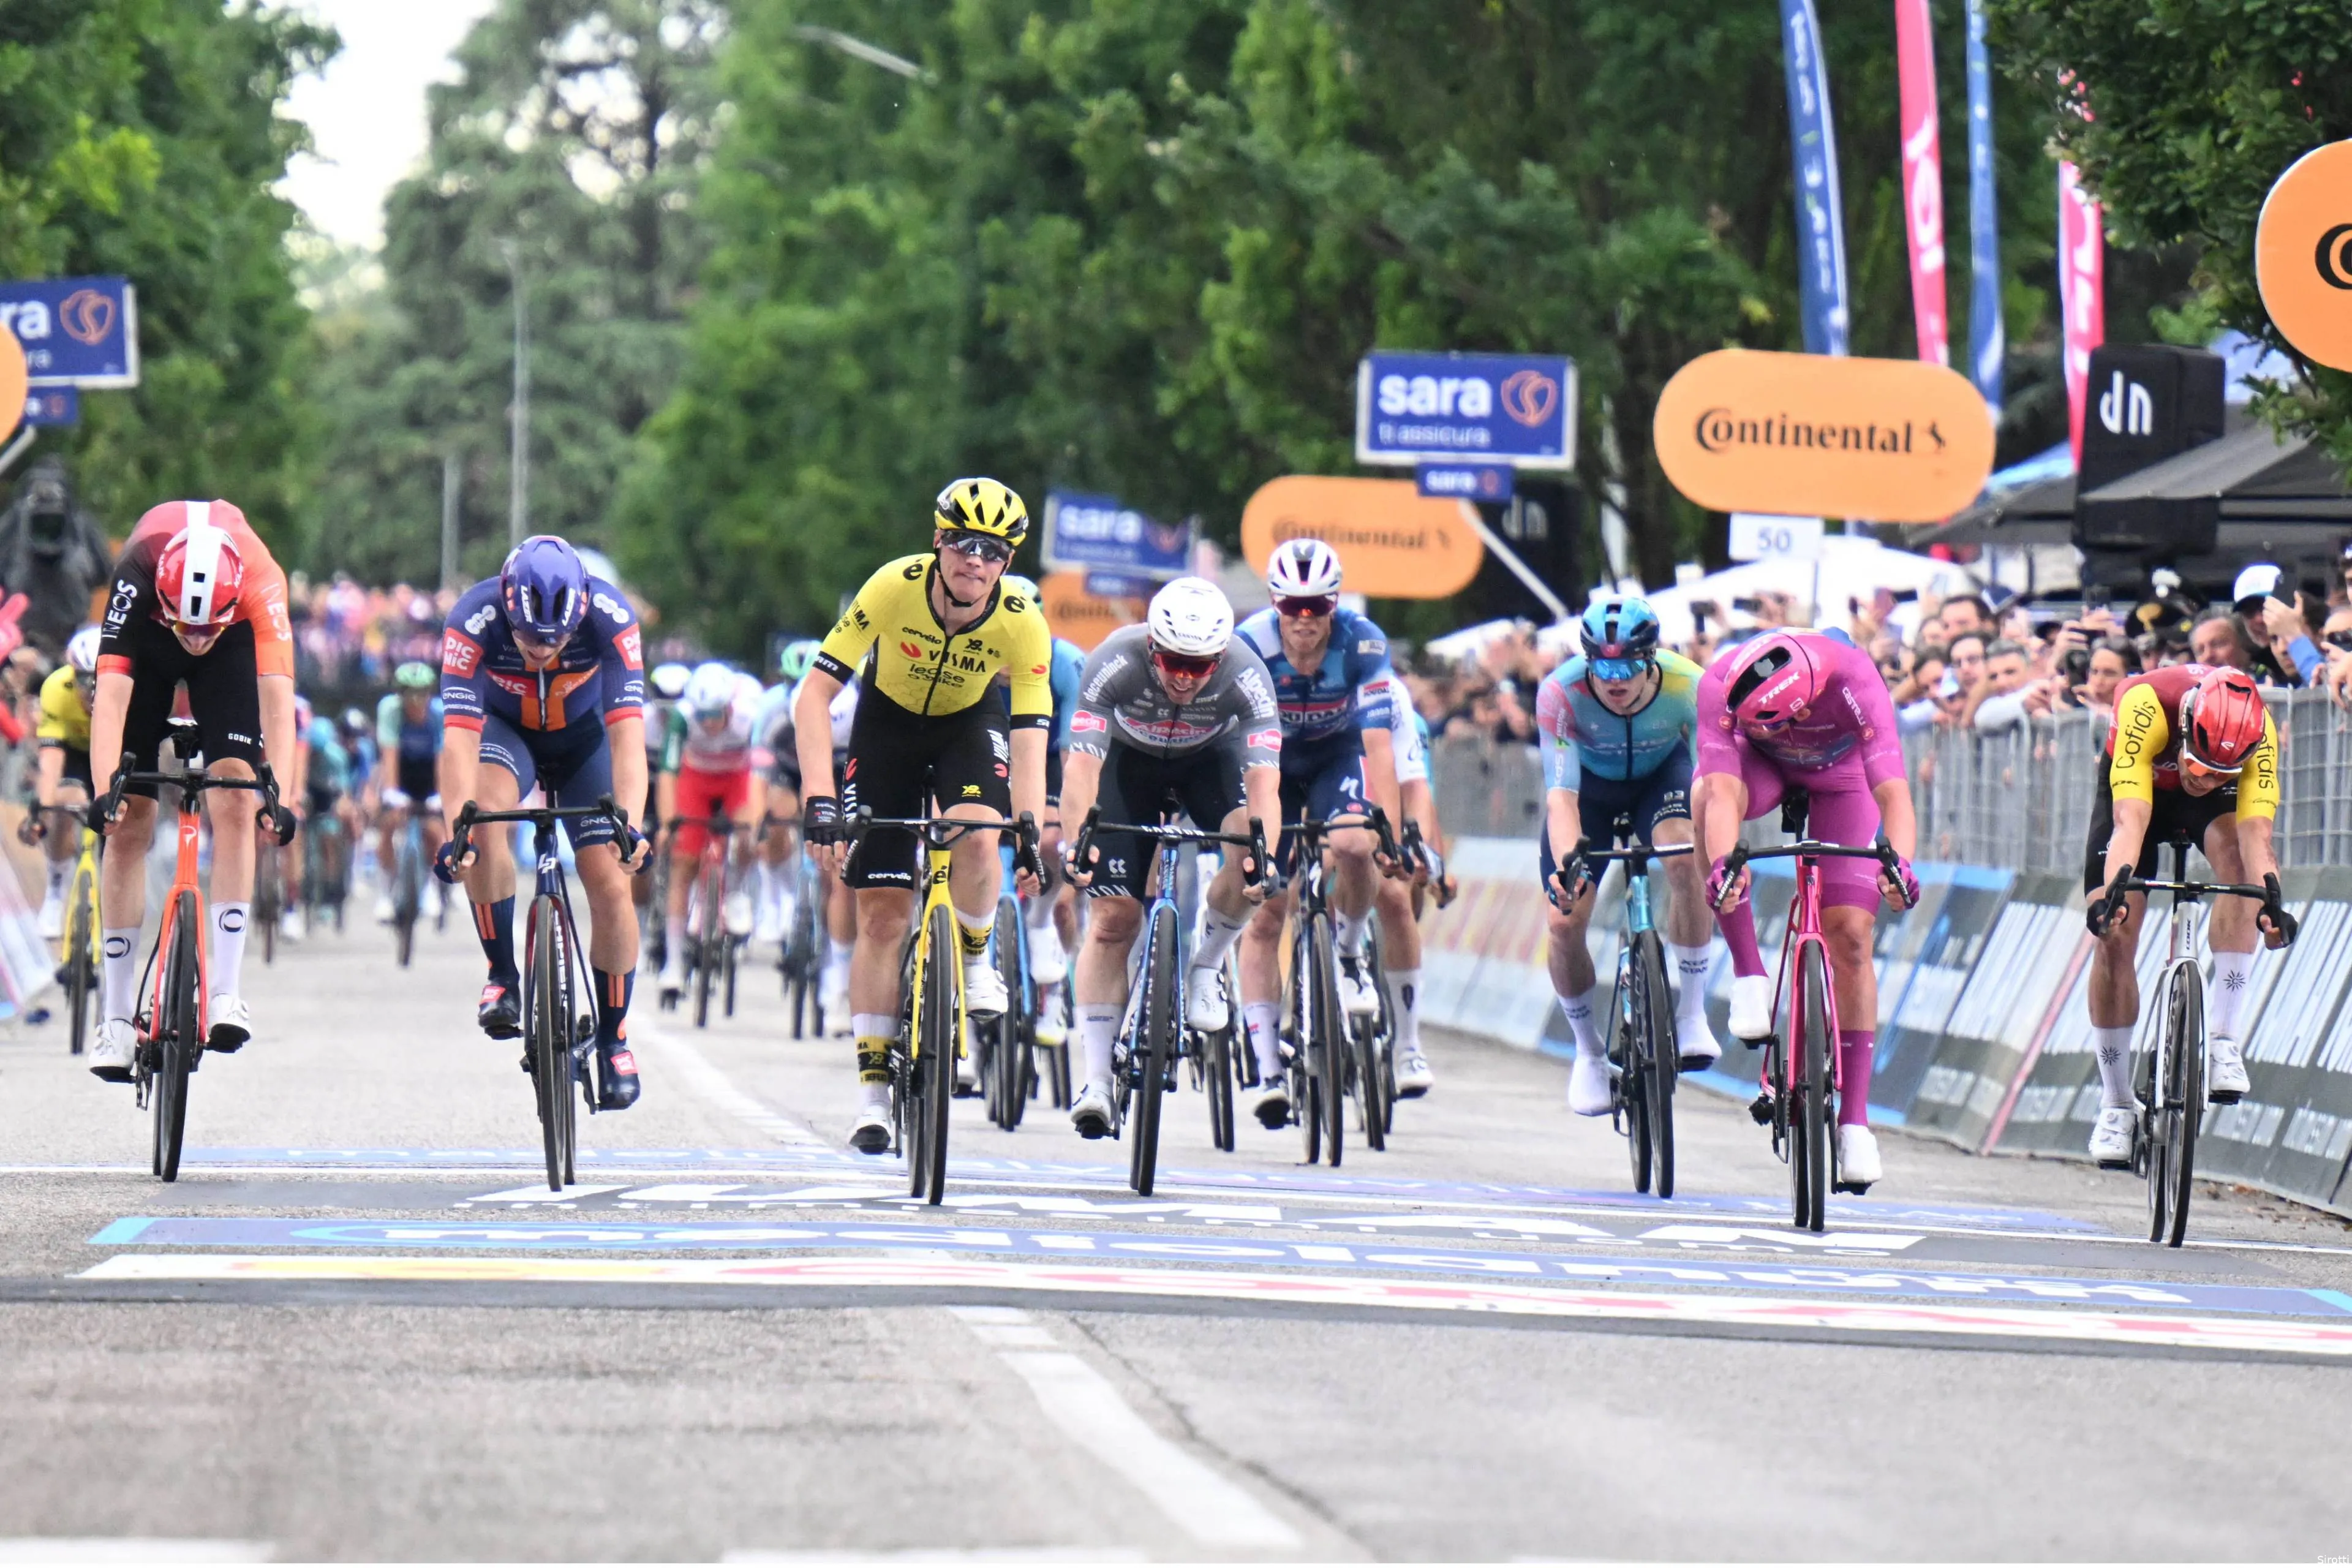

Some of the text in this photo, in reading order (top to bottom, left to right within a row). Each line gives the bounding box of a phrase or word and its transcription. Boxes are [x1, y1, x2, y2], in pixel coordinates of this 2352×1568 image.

[1378, 375, 1493, 418] sara
[1397, 424, 1491, 447] assicura
[1695, 407, 1913, 454] Continental
[1757, 527, 1792, 551] 50
[102, 579, 138, 639] INEOS
[902, 627, 942, 644] cervélo
[910, 663, 965, 684] lease
[929, 650, 986, 673] VISMA
[1084, 654, 1128, 703] deceuninck
[1238, 666, 1276, 718] Alpecin
[1758, 671, 1801, 705] TREK
[2116, 701, 2157, 769] Cofidis
[453, 1202, 1891, 1256] intimissimi uomo
[383, 1229, 2193, 1303] mediolanum
[720, 1264, 2352, 1341] CONAD
